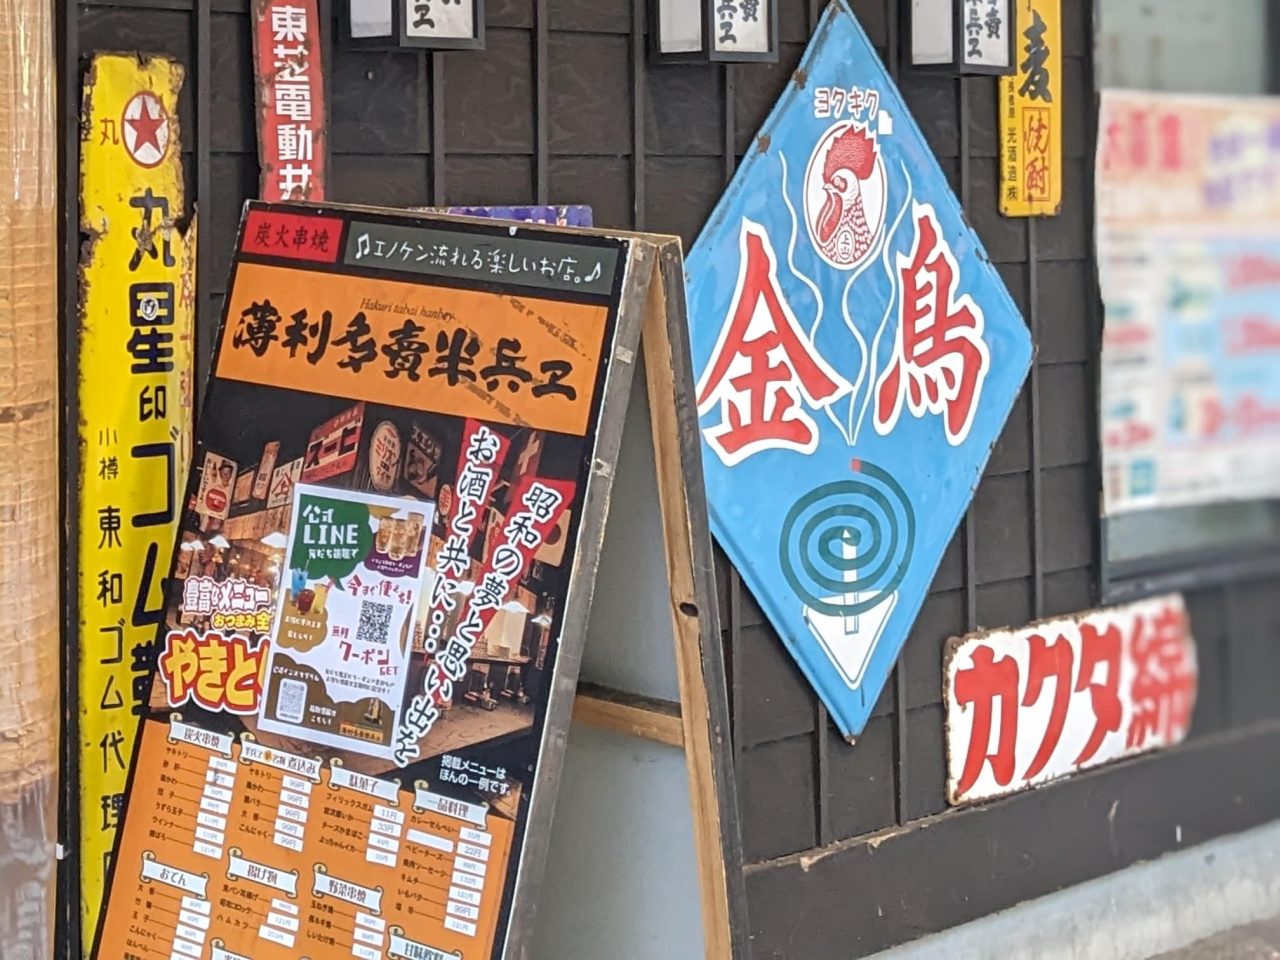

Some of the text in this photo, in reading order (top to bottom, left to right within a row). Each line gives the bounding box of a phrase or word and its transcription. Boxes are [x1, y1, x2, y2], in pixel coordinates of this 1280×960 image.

[1018, 9, 1052, 103] 麦
[814, 87, 878, 120] ヨクキク
[99, 117, 120, 146] 丸
[1024, 113, 1049, 197] 焼酎
[254, 222, 331, 253] 炭火串焼
[360, 297, 393, 312] Hakuri
[393, 302, 419, 316] tabai
[698, 208, 988, 466] 金鳥
[302, 504, 334, 524] 公式
[303, 524, 359, 545] LINE
[394, 484, 560, 766] 昭和の夢と思い出を
[338, 641, 390, 666] クーポン
[379, 666, 399, 676] GET
[954, 623, 1122, 796] カクタ
[441, 754, 507, 780] 掲載メニューは
[381, 809, 398, 821] 11円
[428, 797, 470, 816] 一品料理
